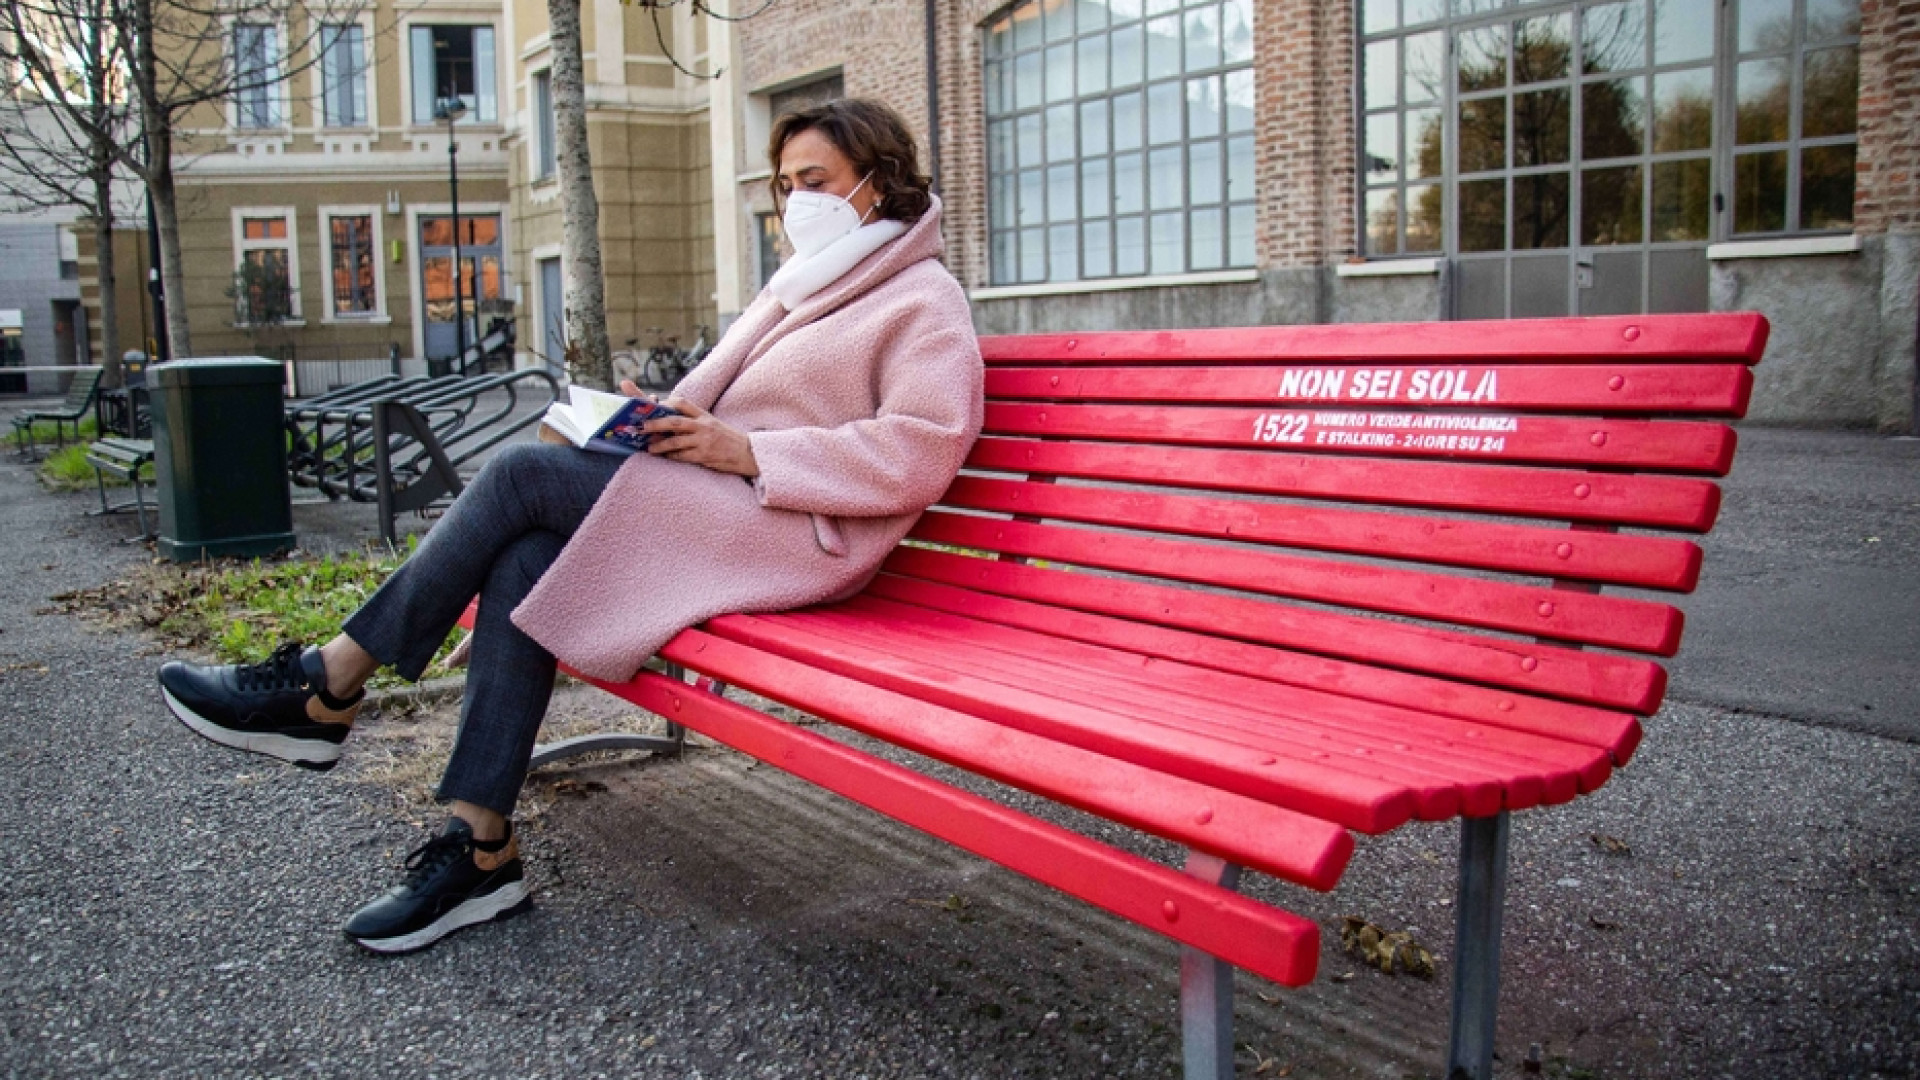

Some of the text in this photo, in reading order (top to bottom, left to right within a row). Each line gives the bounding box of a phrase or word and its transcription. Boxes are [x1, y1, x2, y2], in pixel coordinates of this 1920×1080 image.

[1278, 370, 1497, 400] NON SEI SOLA
[1253, 413, 1309, 442] 1522
[1313, 412, 1517, 431] NUMERO VERDE ANTIVIOLENZA
[1317, 431, 1327, 444] E
[1328, 431, 1394, 446] STALKING
[1424, 434, 1458, 449] ORE
[1458, 435, 1480, 450] SU
